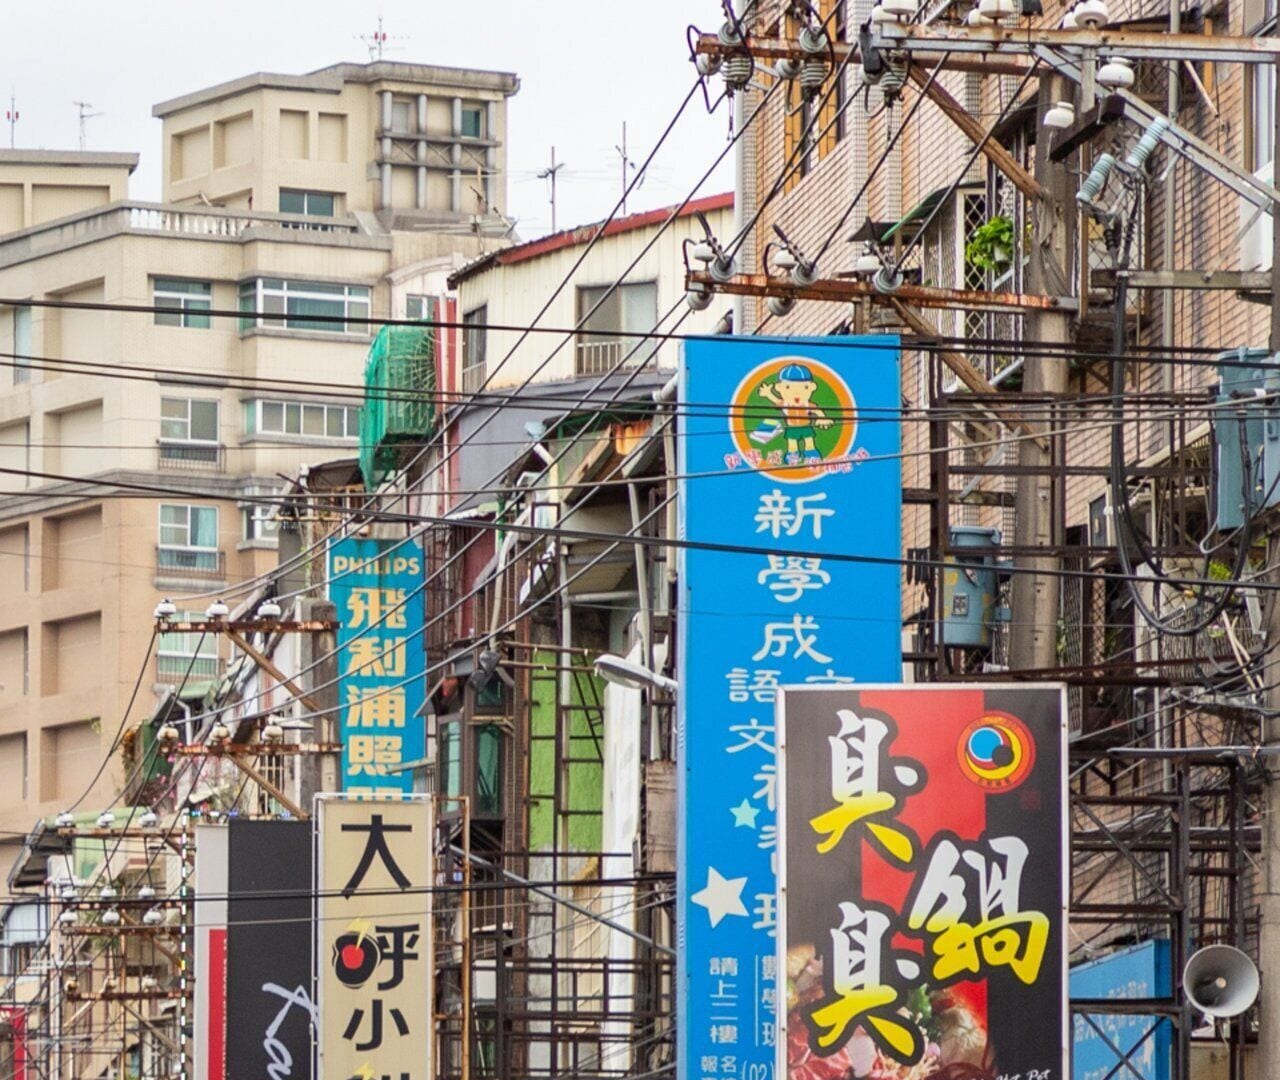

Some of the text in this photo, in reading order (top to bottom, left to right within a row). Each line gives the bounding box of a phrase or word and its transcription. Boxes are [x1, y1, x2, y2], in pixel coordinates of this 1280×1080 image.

[333, 554, 421, 577] PHILIPS
[752, 488, 836, 664] 新學成
[344, 587, 408, 800] 飛利浦照
[910, 836, 1051, 986] 鍋
[709, 956, 739, 1045] 請上二樓
